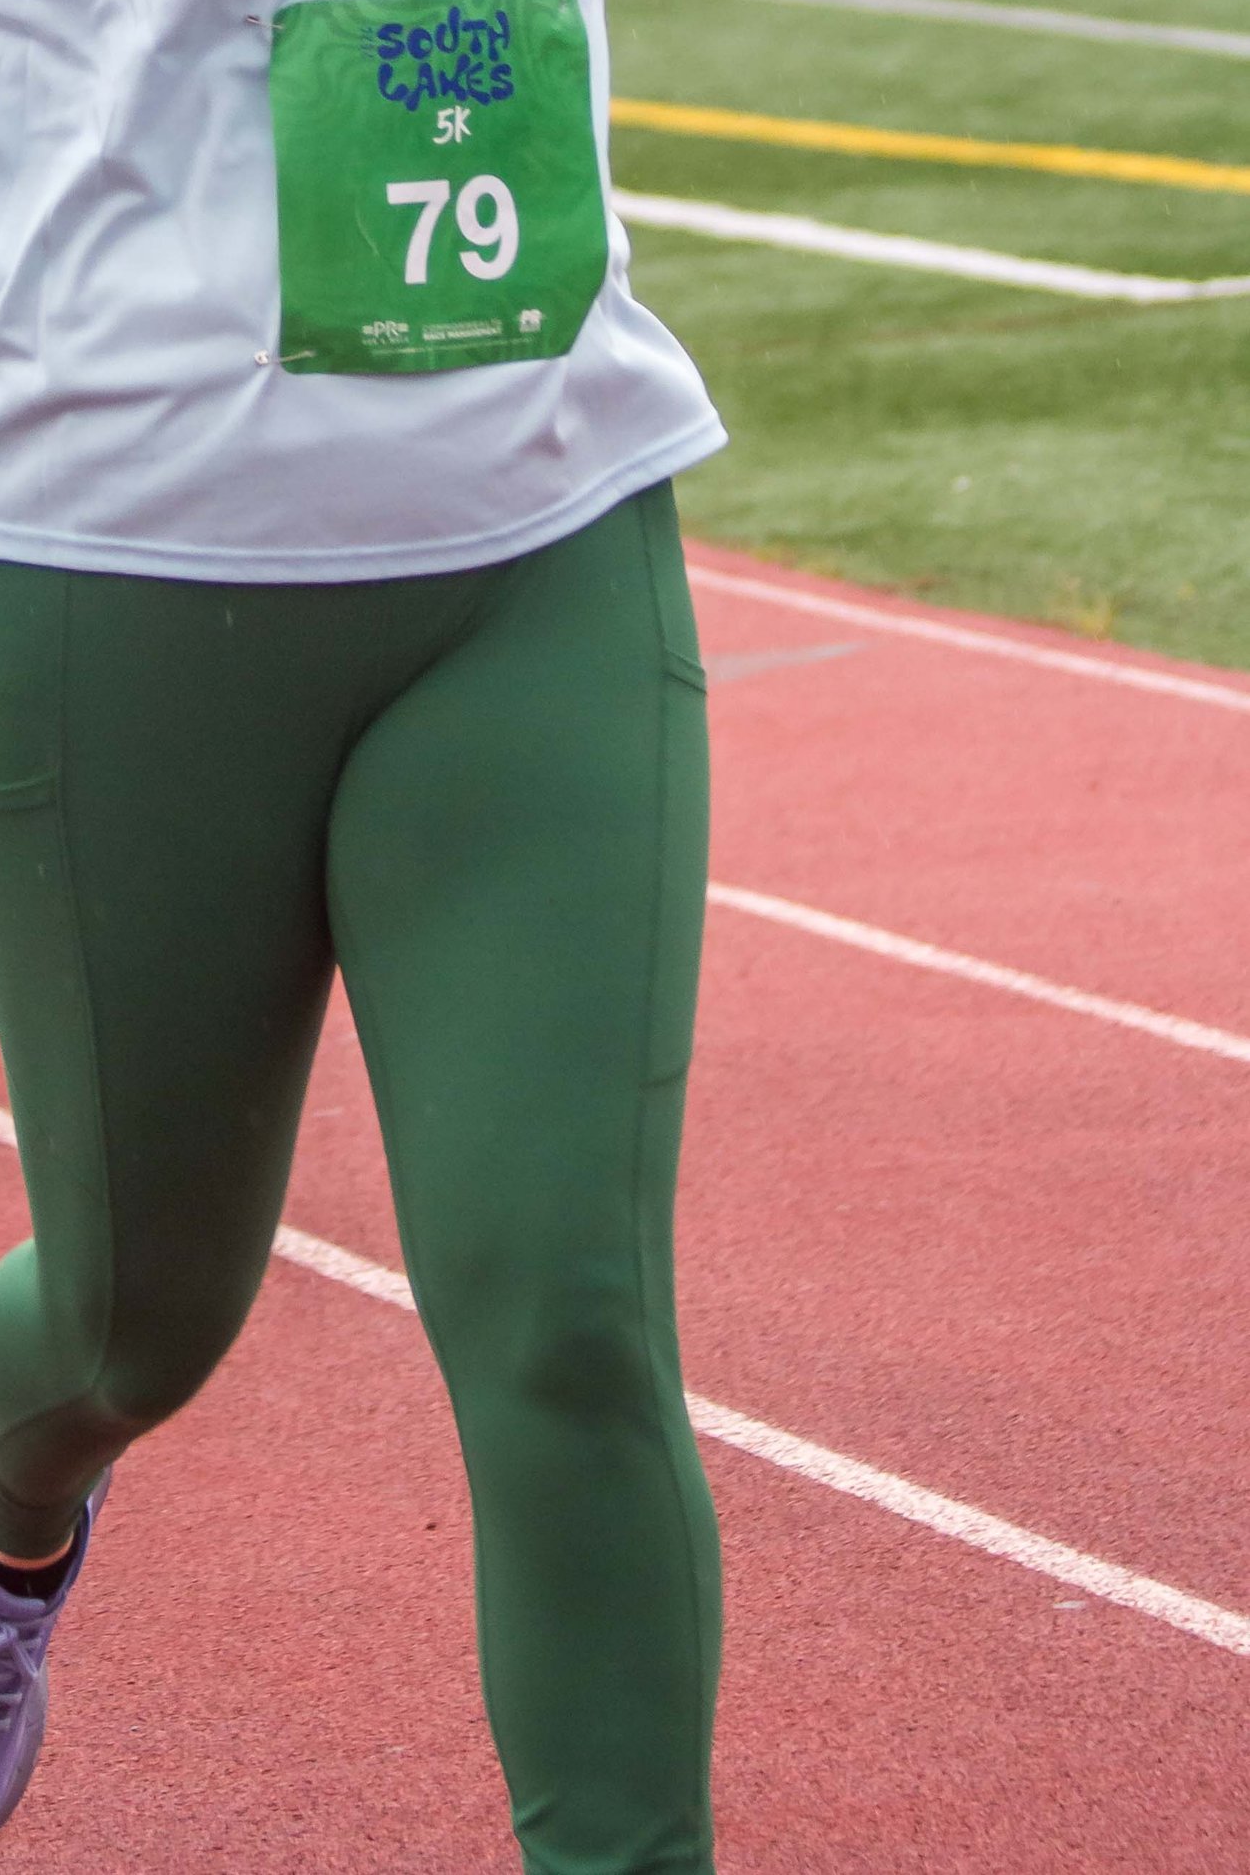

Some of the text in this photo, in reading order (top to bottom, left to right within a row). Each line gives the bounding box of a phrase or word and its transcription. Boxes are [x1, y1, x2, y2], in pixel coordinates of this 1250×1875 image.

[377, 6, 510, 61] SOUTH
[378, 54, 514, 112] LAKES
[432, 105, 472, 145] 5K
[386, 175, 520, 285] 79
